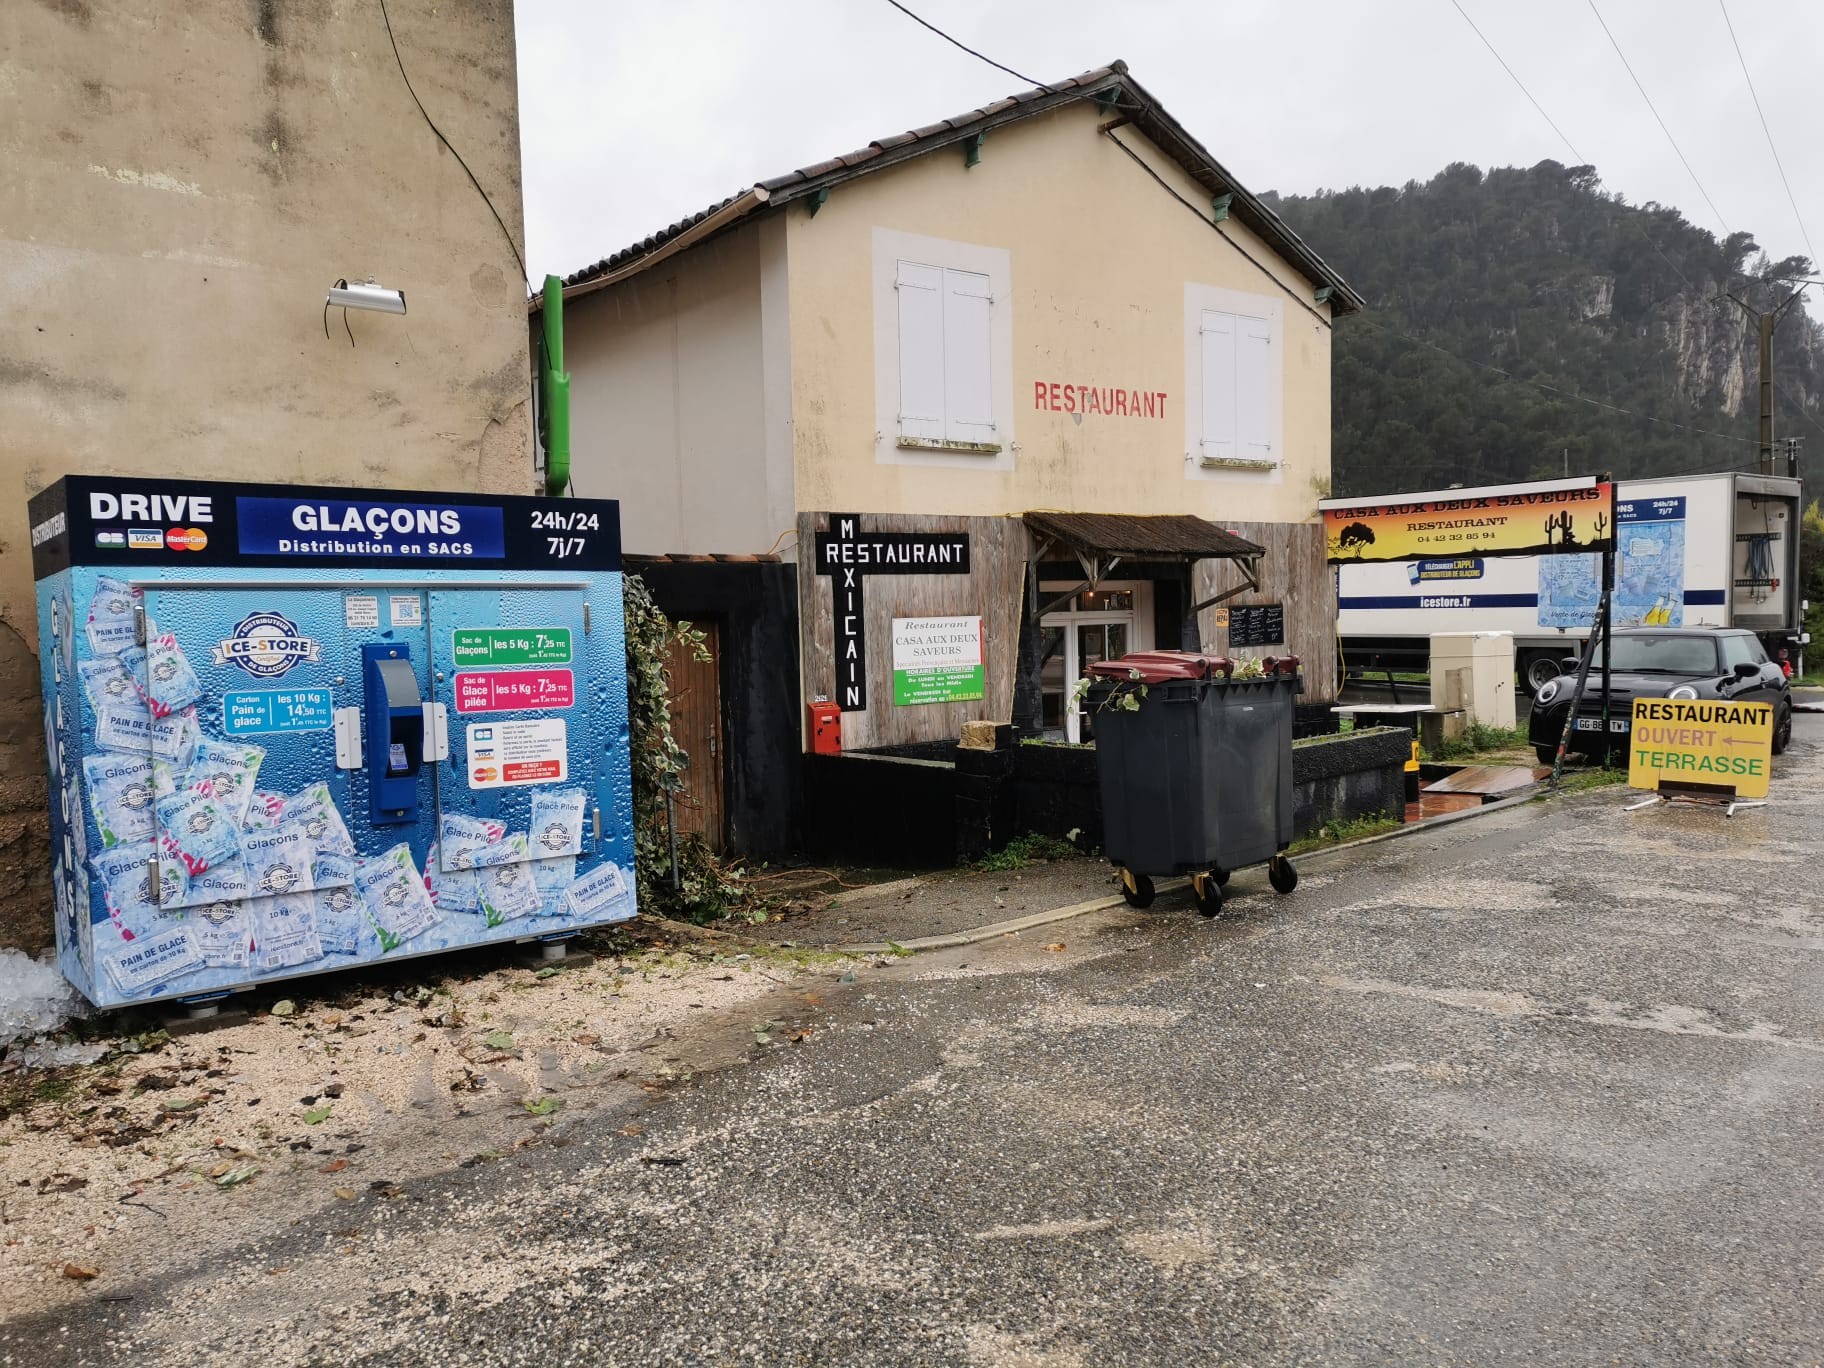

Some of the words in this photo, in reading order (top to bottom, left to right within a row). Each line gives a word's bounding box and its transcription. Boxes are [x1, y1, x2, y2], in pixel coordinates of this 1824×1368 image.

[1035, 381, 1167, 419] RESTAURANT
[89, 492, 214, 523] DRIVE
[1334, 507, 1380, 520] CASA
[1385, 502, 1427, 516] AUX
[1433, 498, 1490, 513] DEUX
[1497, 488, 1601, 507] SAVEURS
[291, 504, 462, 539] GLAÇONS
[531, 511, 600, 531] 24h/24
[1407, 516, 1509, 532] RESTAURANT
[134, 534, 157, 543] VISA
[1434, 534, 1446, 542] 42
[1449, 533, 1463, 542] 32
[1466, 532, 1480, 541] 85
[1482, 532, 1496, 540] 94
[279, 539, 393, 554] Distribution
[400, 543, 421, 554] en
[428, 542, 474, 555] SACS
[547, 537, 586, 558] 7j/7
[826, 543, 964, 563] RESTAURANT
[1420, 596, 1471, 608] icestore.fr
[841, 519, 860, 706] MEXICAIN
[241, 617, 289, 632] DISTRIBUTEUR
[905, 621, 968, 630] Restaurant
[225, 639, 309, 655] ICE-STORE
[494, 639, 508, 649] les
[509, 640, 516, 648] 5
[517, 639, 529, 650] Kg
[895, 636, 924, 645] CASA
[926, 635, 948, 644] AUX
[950, 634, 979, 643] DEUX
[456, 646, 489, 656] Glaçons
[913, 646, 962, 657] SAVEURS
[258, 660, 290, 672] GLAÇONS
[462, 686, 488, 695] Glace
[496, 684, 510, 694] les
[511, 684, 517, 693] 5
[519, 684, 531, 695] Kg
[278, 695, 292, 704] les
[294, 694, 306, 703] 10
[307, 693, 321, 704] Kg
[464, 696, 487, 709] pilée
[231, 705, 255, 715] Pain
[1635, 703, 1771, 726] RESTAURANT
[110, 716, 131, 728] PAIN
[133, 720, 145, 730] DE
[234, 717, 262, 729] glace
[1637, 726, 1718, 747] OUVERT
[208, 752, 249, 770] Glaçons
[1635, 750, 1764, 776] TERRASSE
[105, 762, 153, 779] Glaçons
[247, 832, 299, 850] Glaçons
[446, 827, 473, 840] Glace
[109, 857, 146, 876] Glace
[367, 862, 404, 885] Glaçons
[120, 952, 144, 969] PAIN
[145, 946, 157, 959] DE
[158, 934, 188, 954] GLACE
